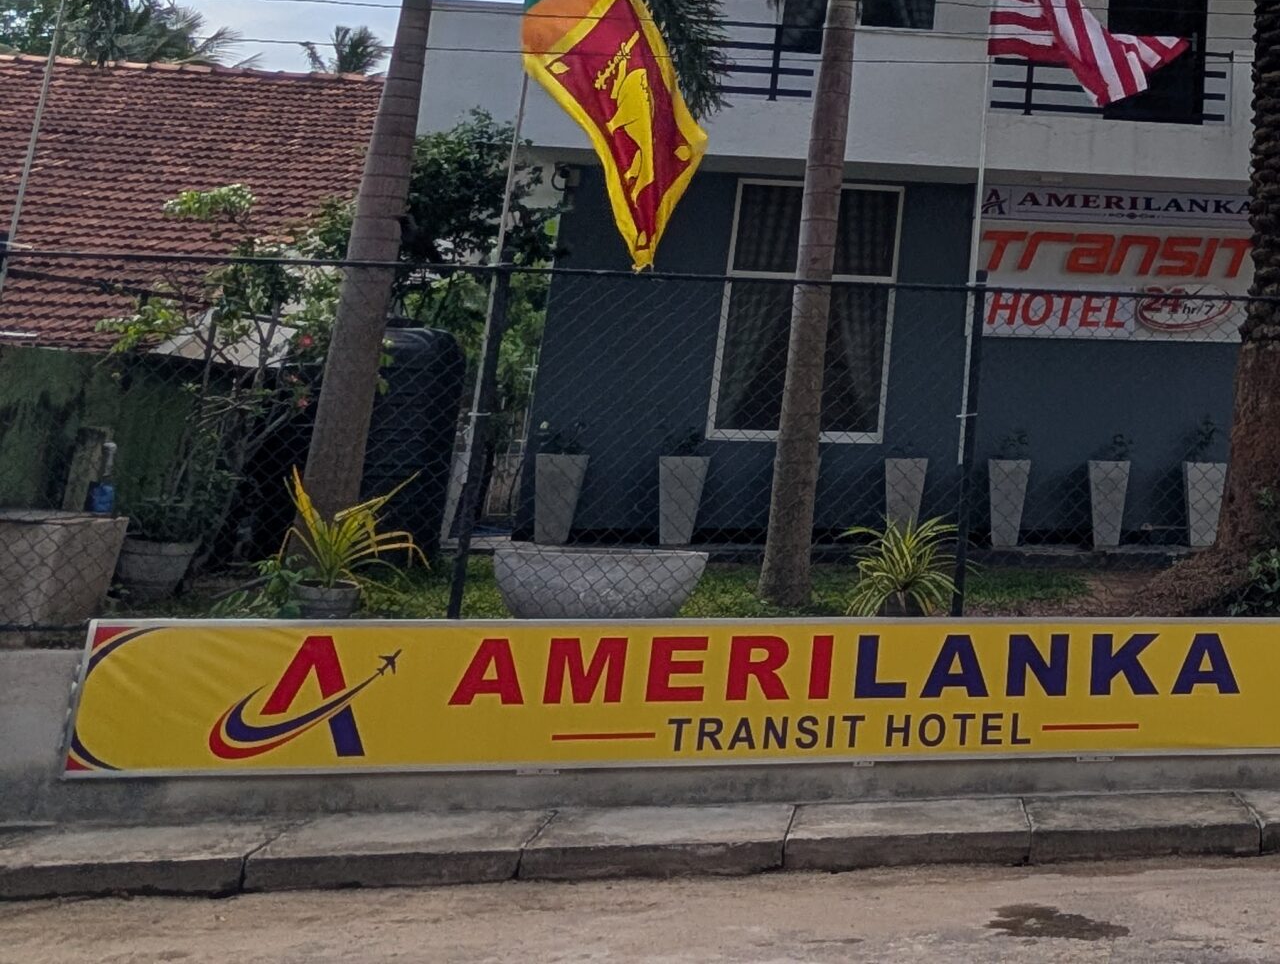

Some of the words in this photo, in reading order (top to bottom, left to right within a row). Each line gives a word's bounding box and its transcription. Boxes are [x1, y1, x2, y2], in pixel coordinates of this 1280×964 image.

[1017, 192, 1251, 215] AMERILANKA
[986, 290, 1125, 329] HOTEL
[447, 633, 1240, 706] AMERILANKA
[666, 714, 865, 752] TRANSIT
[885, 712, 1032, 748] HOTEL
